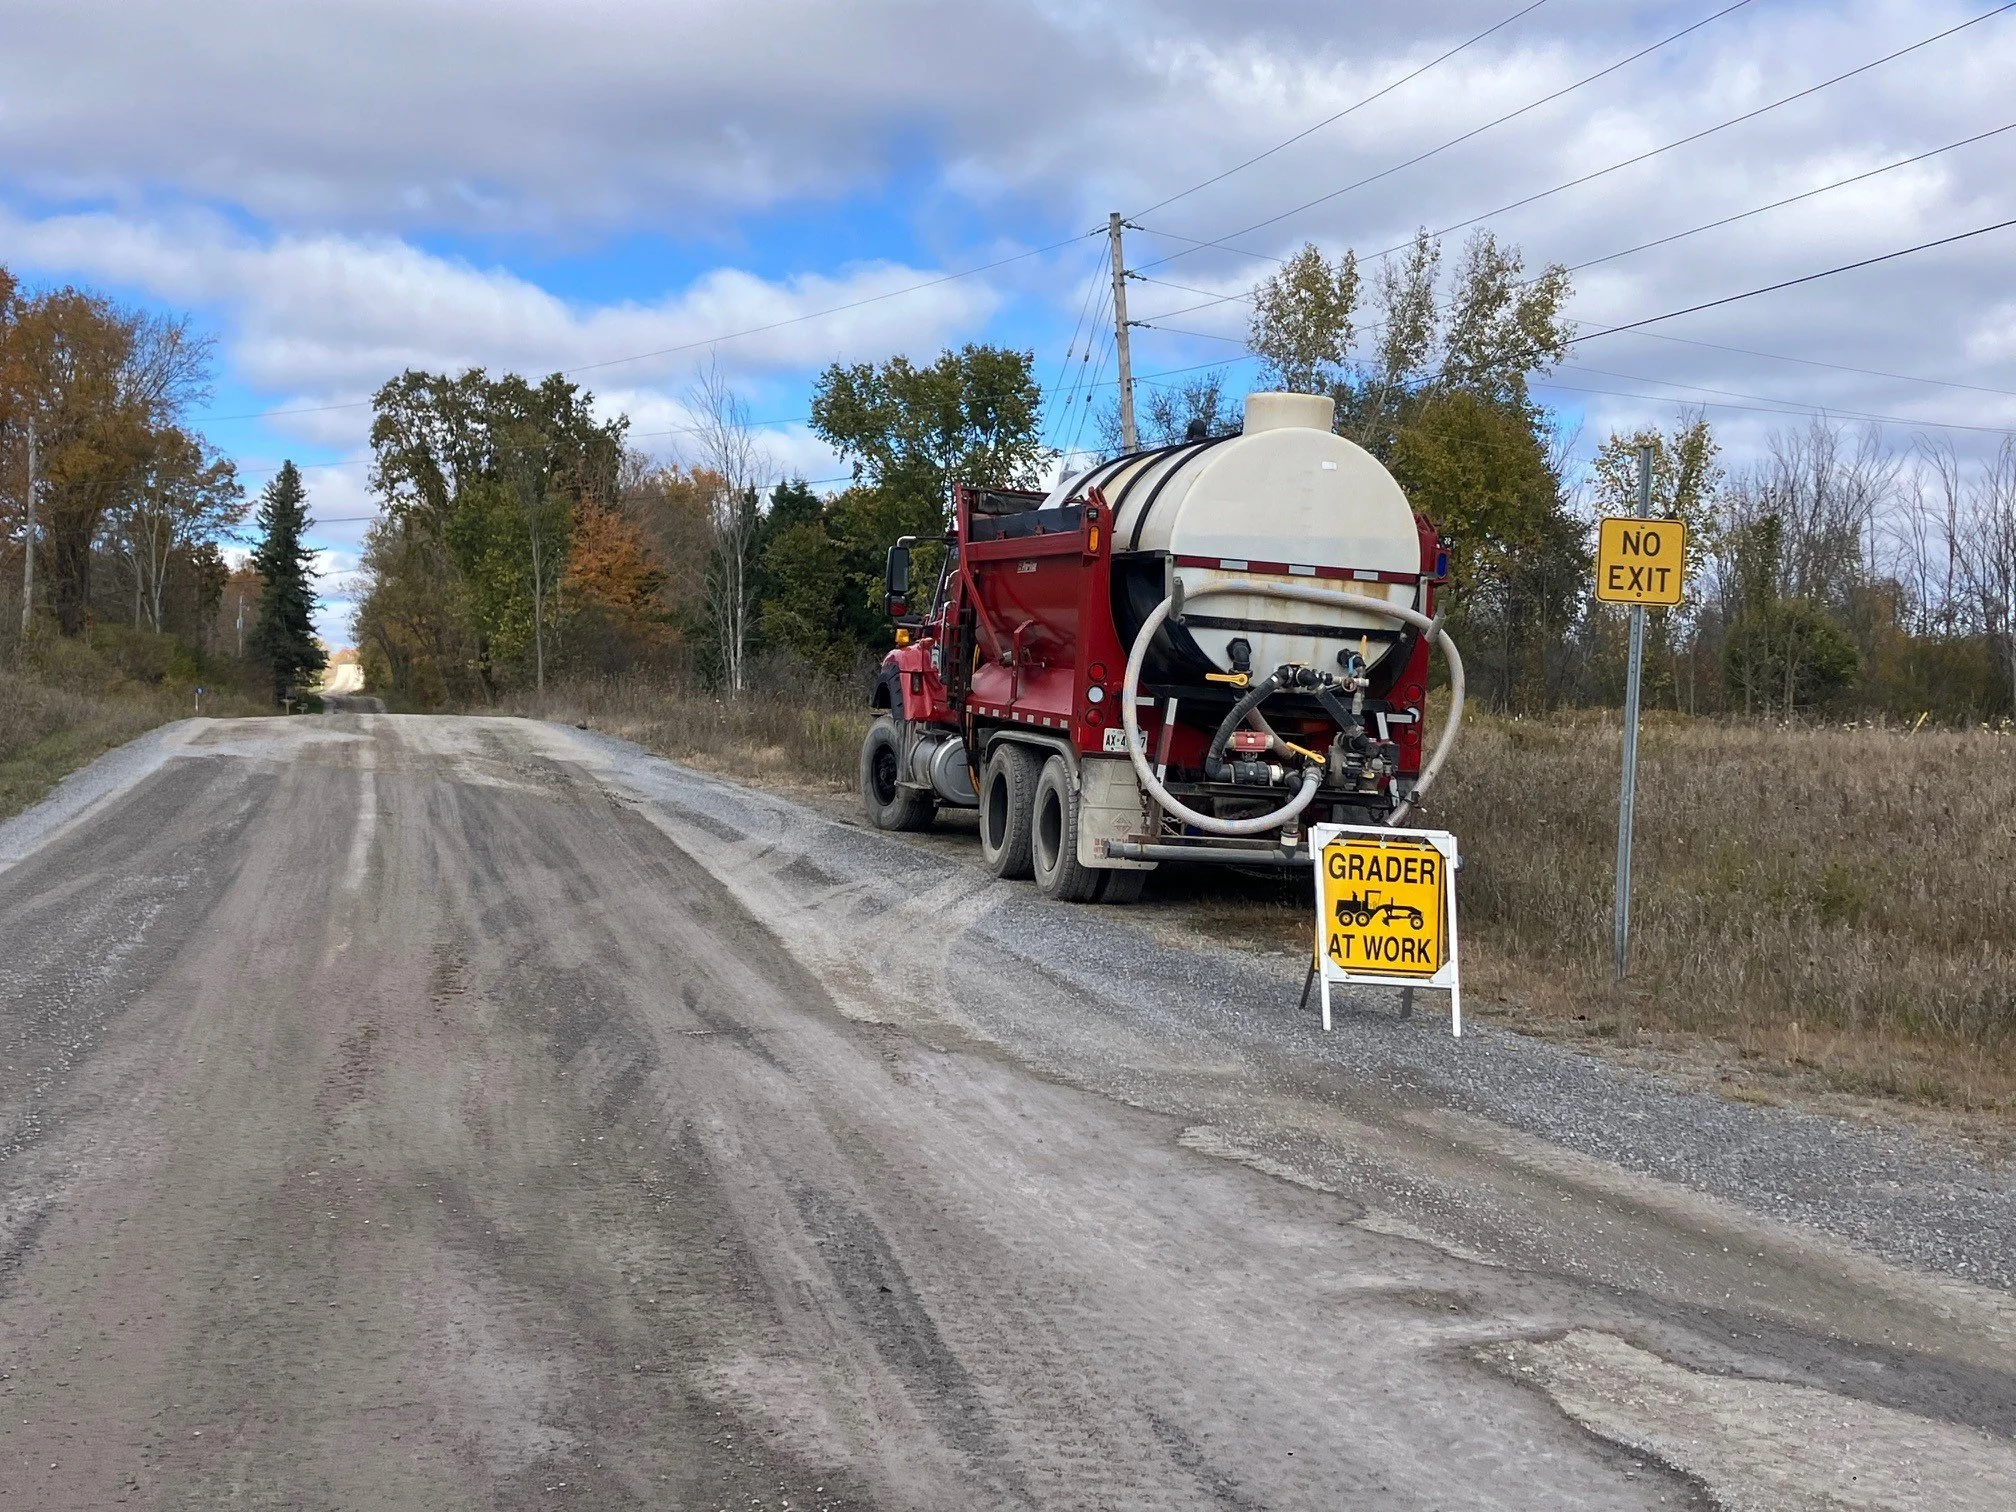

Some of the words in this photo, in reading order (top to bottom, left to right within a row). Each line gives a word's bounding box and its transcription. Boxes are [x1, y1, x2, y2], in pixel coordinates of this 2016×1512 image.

[1622, 530, 1660, 557] NO
[1608, 565, 1671, 592] EXIT
[1328, 852, 1436, 885] GRADER
[1328, 933, 1356, 959] AT
[1363, 935, 1432, 964] WORK
